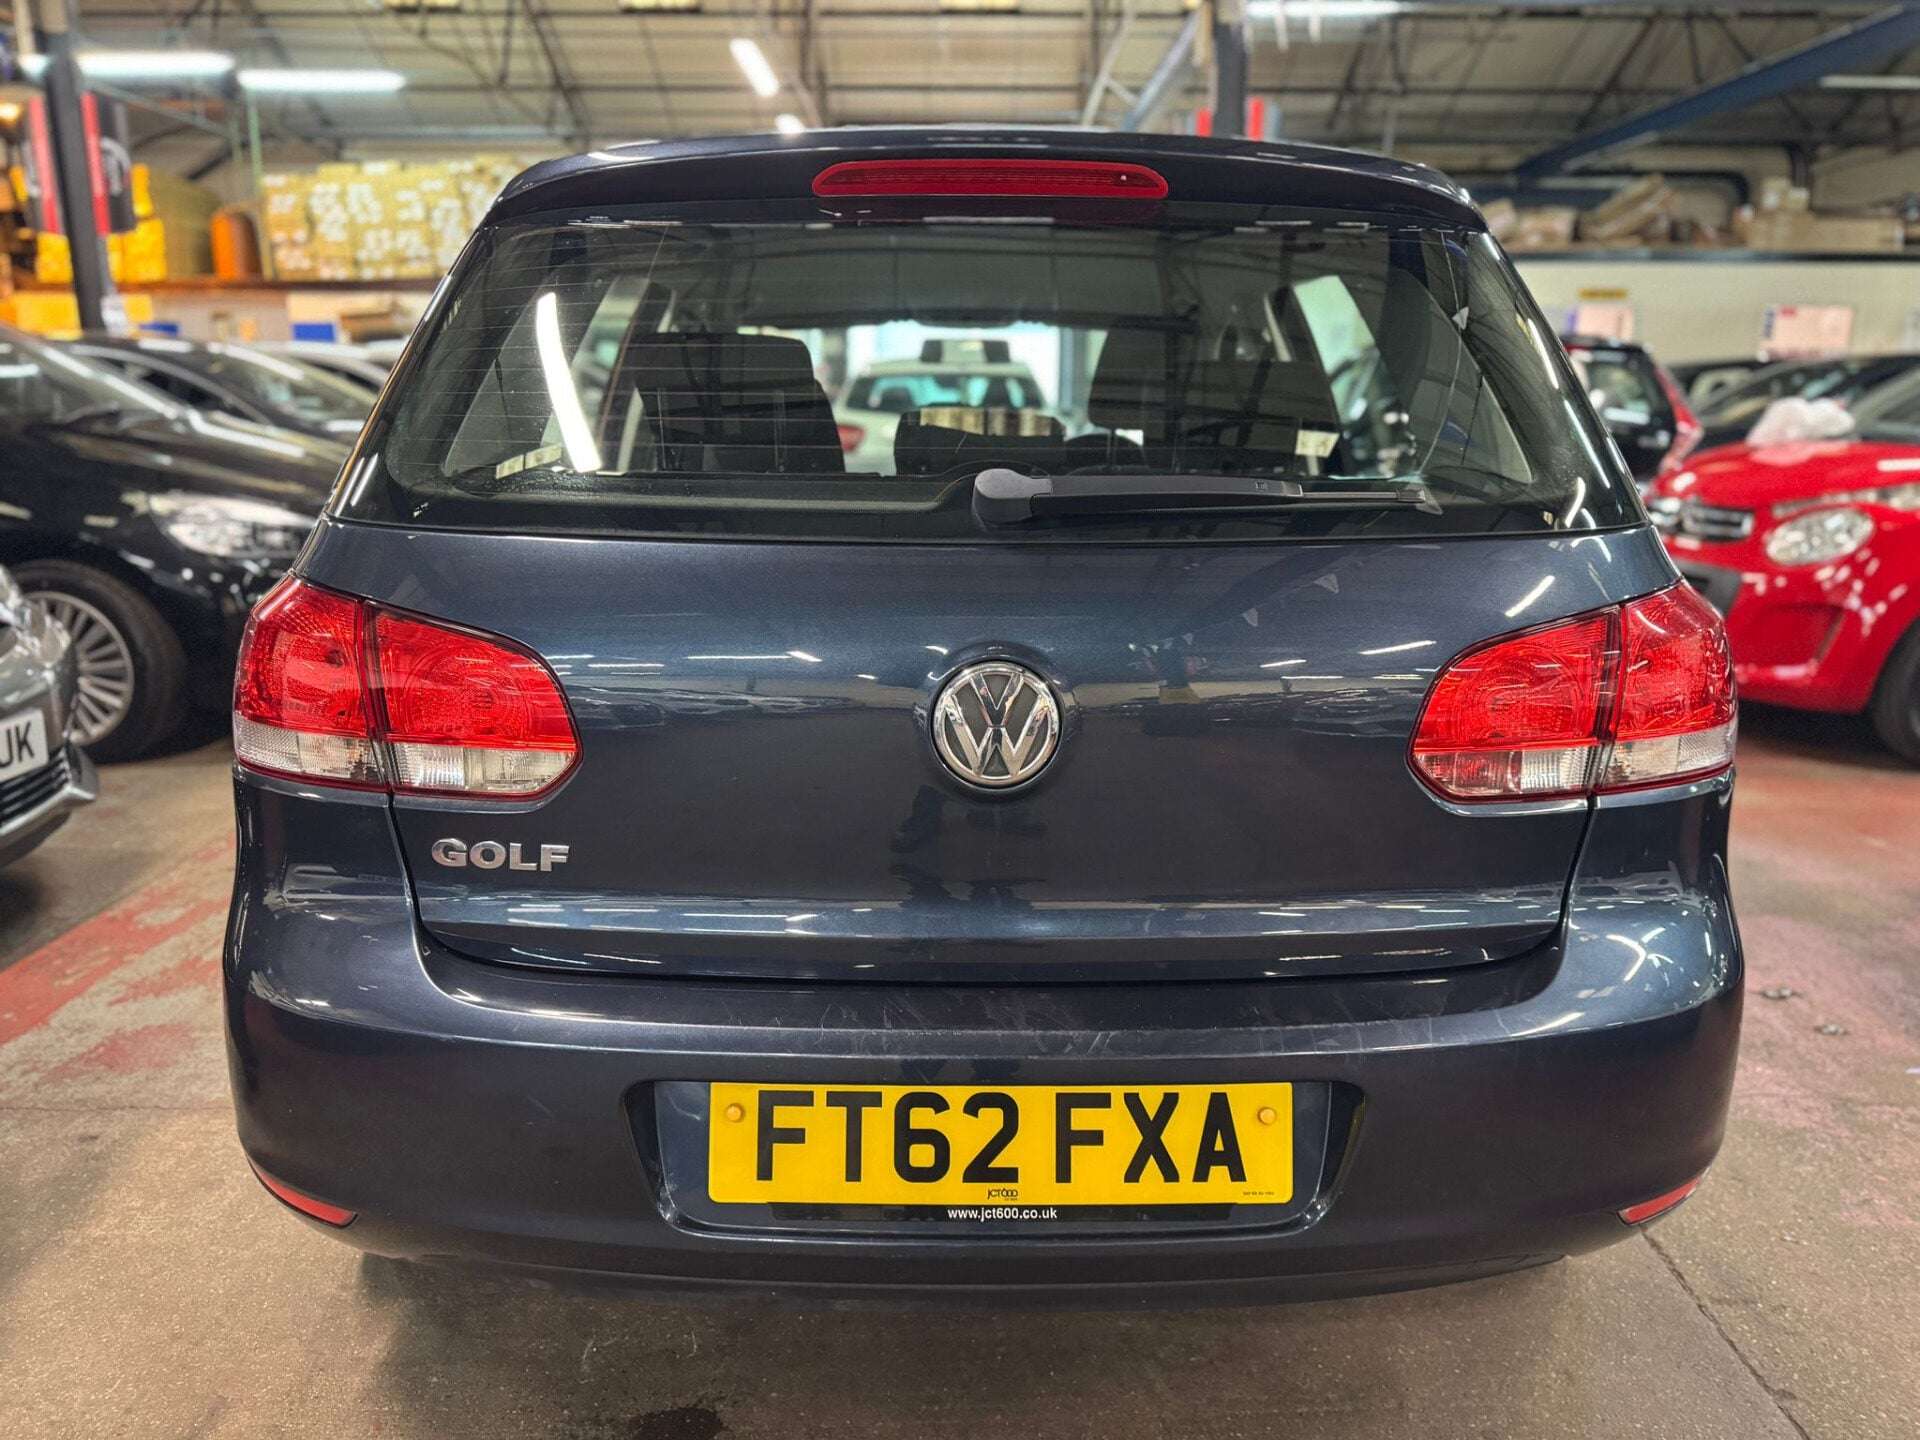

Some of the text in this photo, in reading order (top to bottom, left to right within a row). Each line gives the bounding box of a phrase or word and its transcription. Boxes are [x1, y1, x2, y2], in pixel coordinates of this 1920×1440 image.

[431, 837, 570, 872] GOLF
[756, 1089, 1248, 1184] FT62 FXA
[947, 1206, 1058, 1223] www.jct600.co.uk
